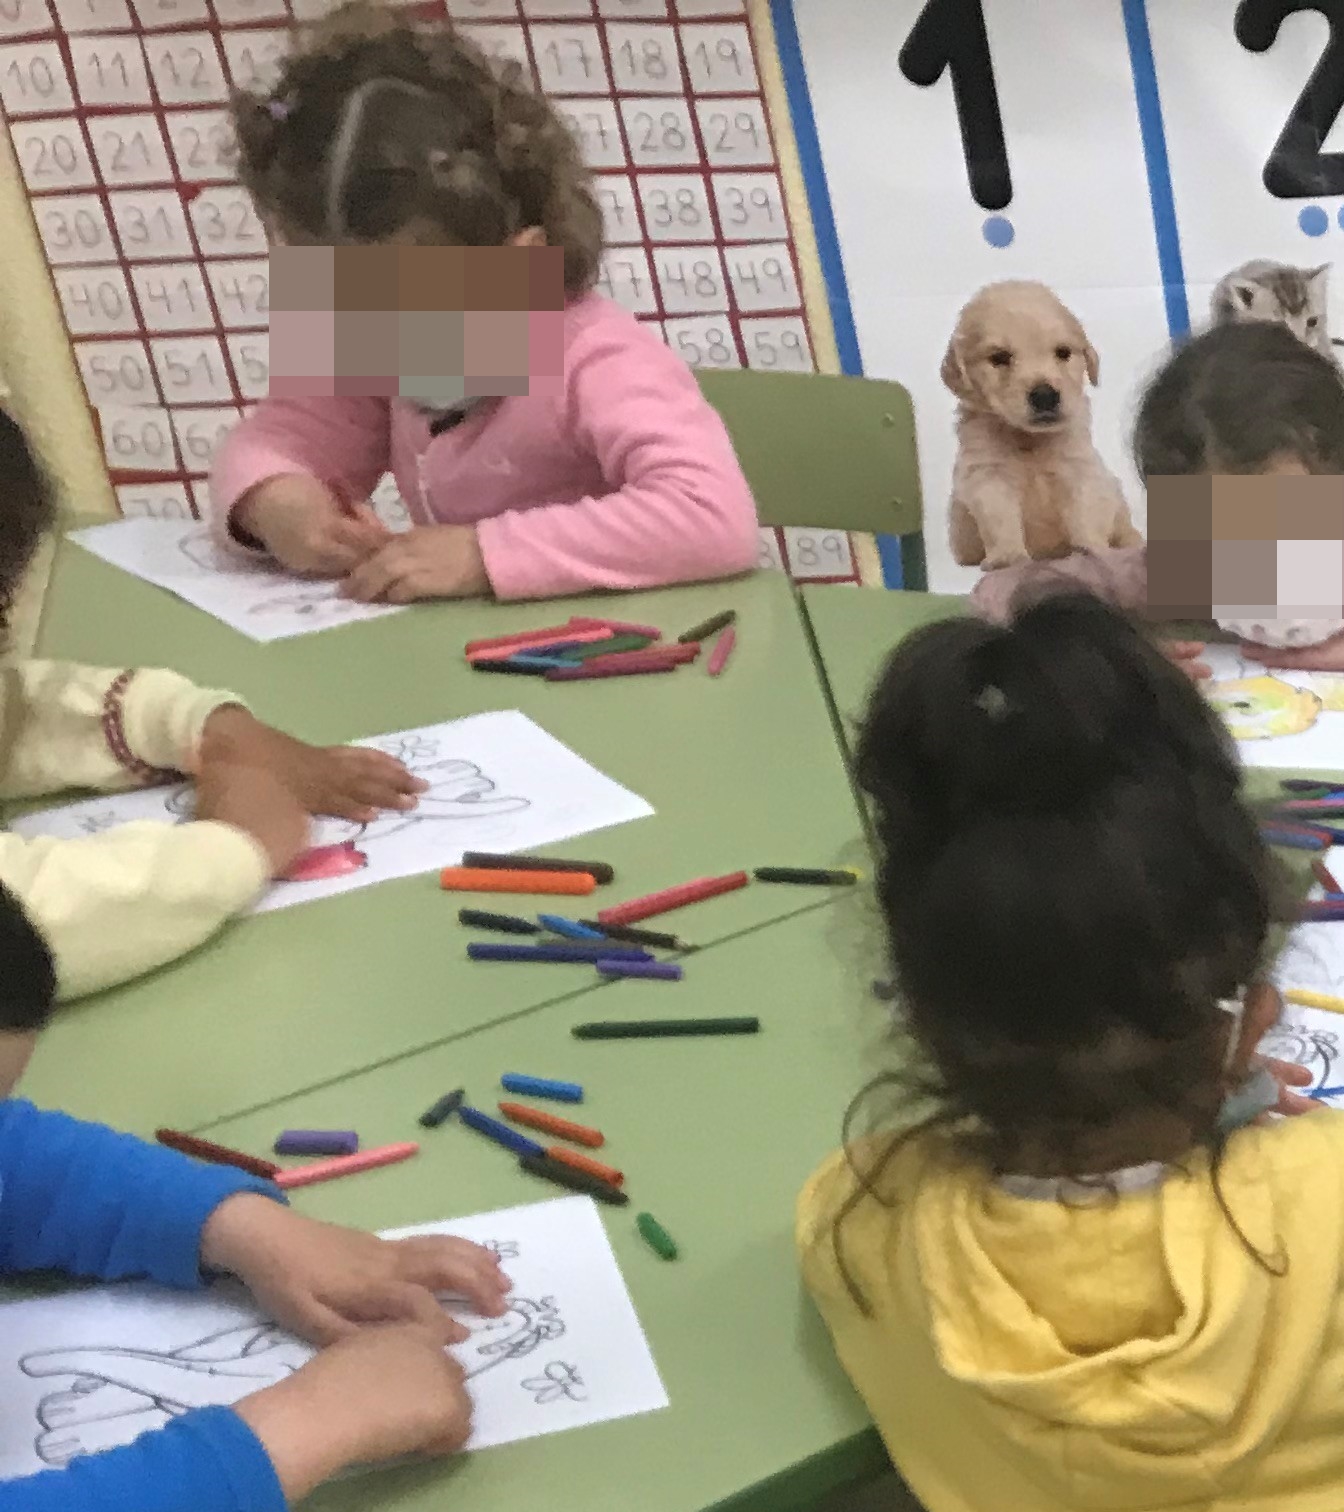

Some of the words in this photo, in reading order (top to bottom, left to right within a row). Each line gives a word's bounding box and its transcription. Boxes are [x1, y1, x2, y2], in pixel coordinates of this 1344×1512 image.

[8, 56, 54, 97] 10
[90, 52, 128, 87] 11
[161, 47, 209, 88] 12
[545, 38, 591, 78] 17
[621, 38, 667, 79] 18
[695, 38, 742, 79] 19
[898, 0, 1013, 210] 1
[25, 134, 78, 175] 20
[102, 130, 150, 171] 21
[634, 111, 685, 151] 28
[709, 112, 758, 152] 29
[45, 209, 100, 248] 30
[122, 205, 174, 243] 31
[199, 200, 254, 240] 32
[649, 188, 700, 227] 38
[725, 187, 772, 224] 39
[68, 281, 123, 320] 40
[146, 278, 195, 315] 41
[665, 261, 717, 297] 48
[736, 258, 787, 295] 49
[90, 354, 144, 392] 50
[164, 350, 214, 386] 51
[677, 328, 731, 366] 58
[755, 331, 804, 366] 59
[111, 420, 163, 457] 60
[798, 535, 844, 566] 89
